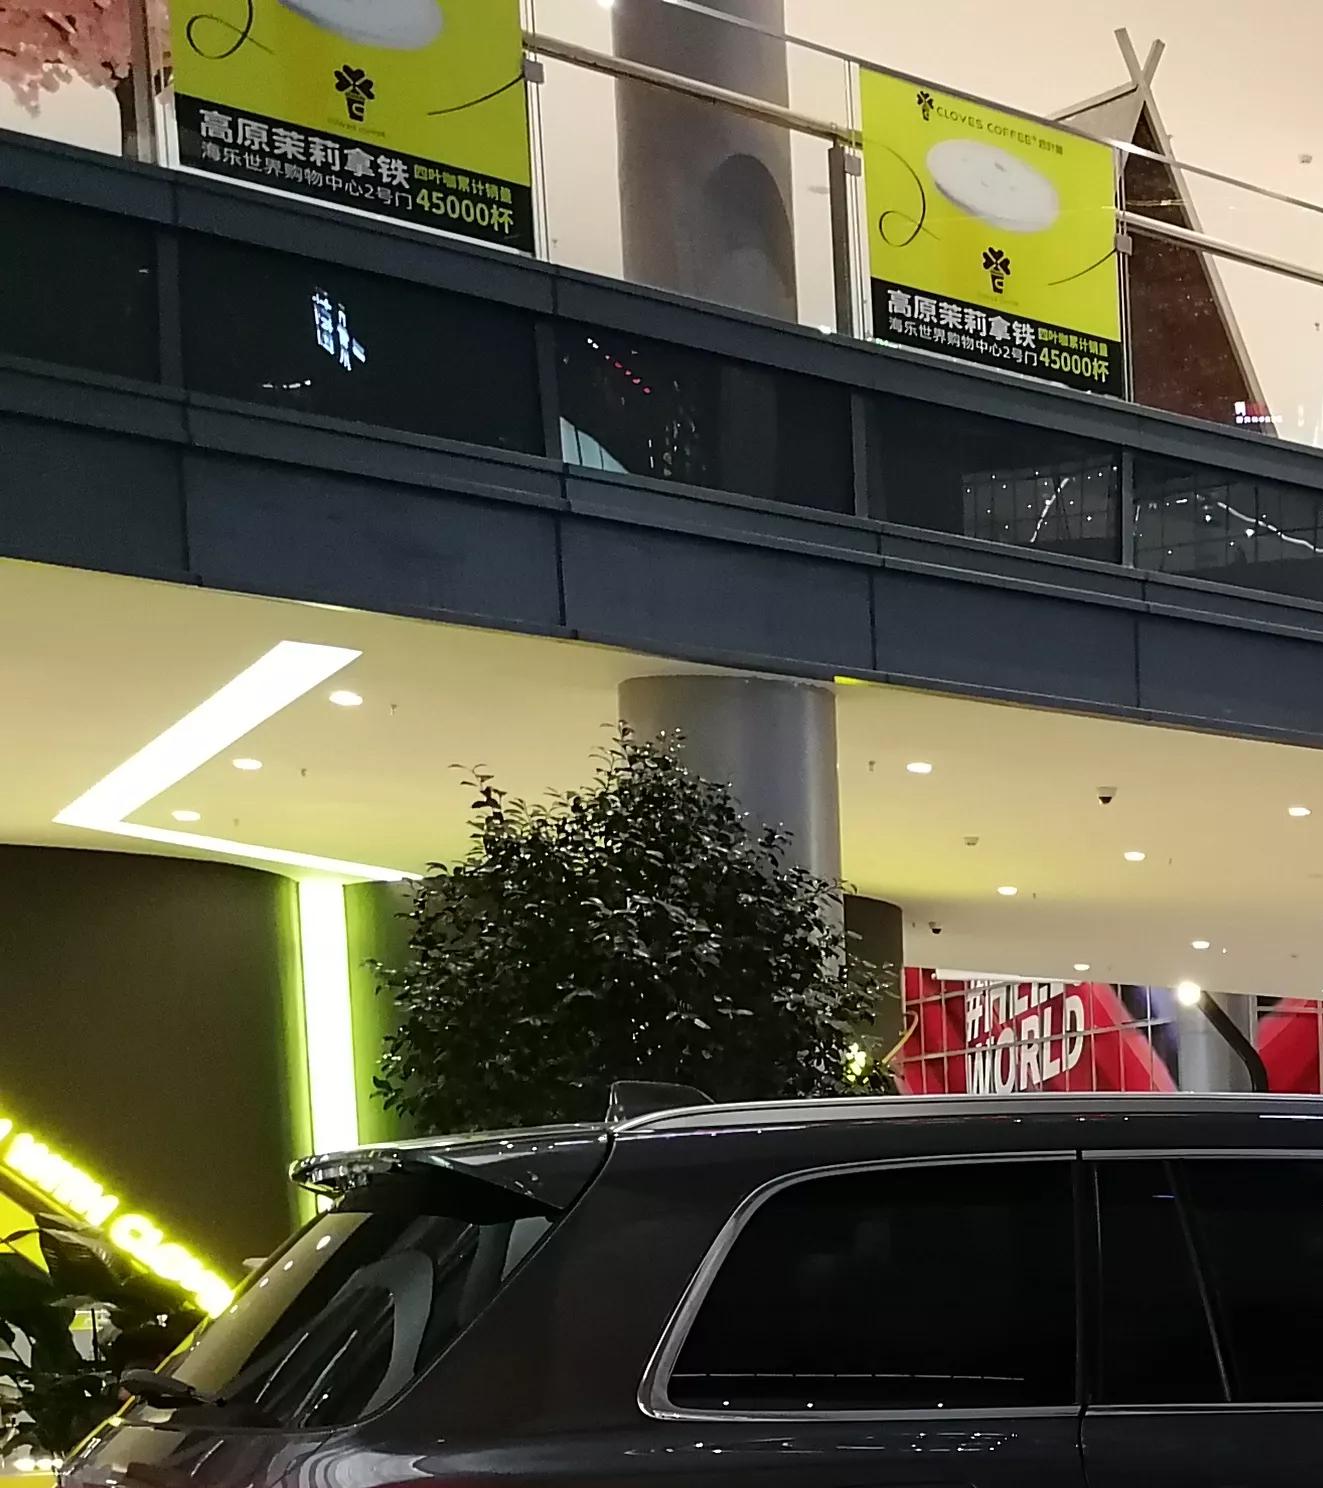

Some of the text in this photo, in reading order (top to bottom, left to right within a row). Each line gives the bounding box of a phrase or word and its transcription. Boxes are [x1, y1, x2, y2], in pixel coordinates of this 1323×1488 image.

[936, 105, 984, 130] CLOVES
[199, 108, 410, 189] 高原茉莉拿铁
[200, 140, 413, 211] 海乐世界购物中心2号门
[415, 188, 515, 235] 45000杯
[887, 289, 1036, 349] 高原茉莉拿铁
[888, 315, 1038, 367] 海乐世界购物中心2号门
[1038, 346, 1110, 384] 45000杯
[966, 994, 1085, 1094] WORLD
